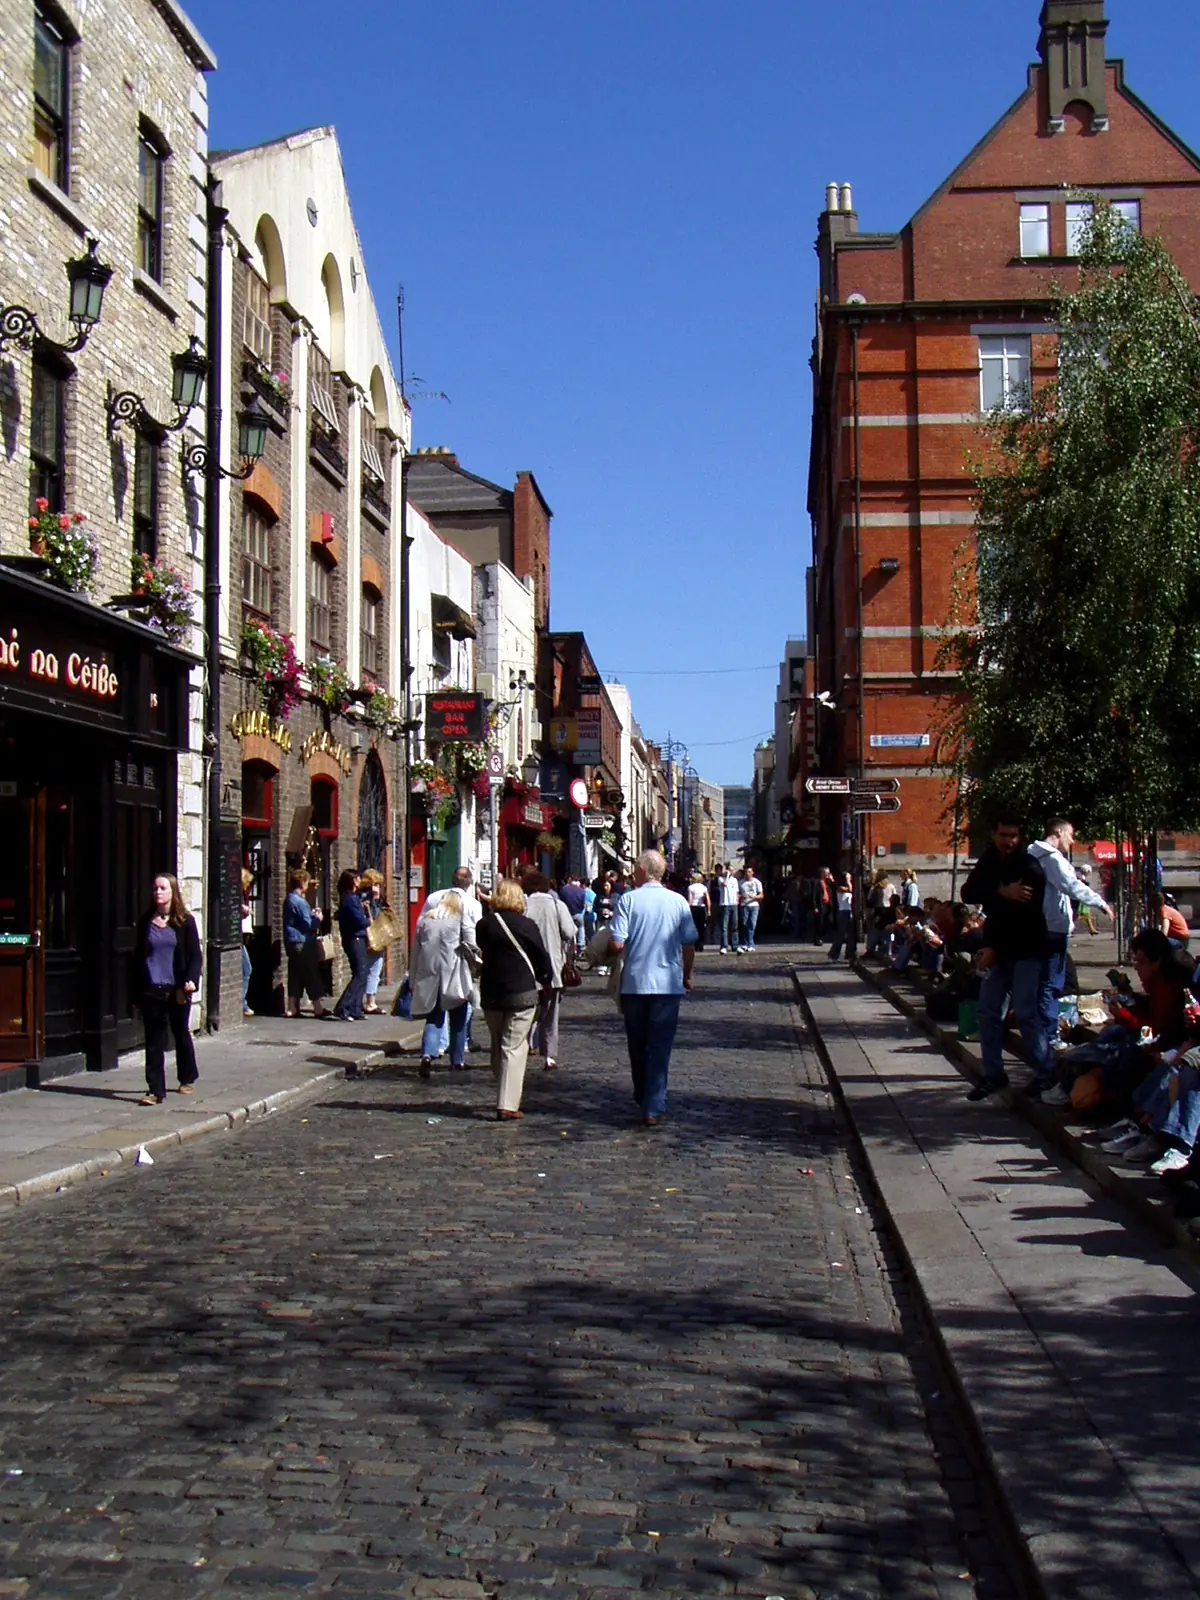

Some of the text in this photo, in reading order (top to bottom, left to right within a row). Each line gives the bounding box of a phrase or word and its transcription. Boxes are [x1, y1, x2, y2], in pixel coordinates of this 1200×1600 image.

[31, 649, 59, 680] na
[445, 712, 465, 723] BAR
[442, 725, 468, 736] OPEN
